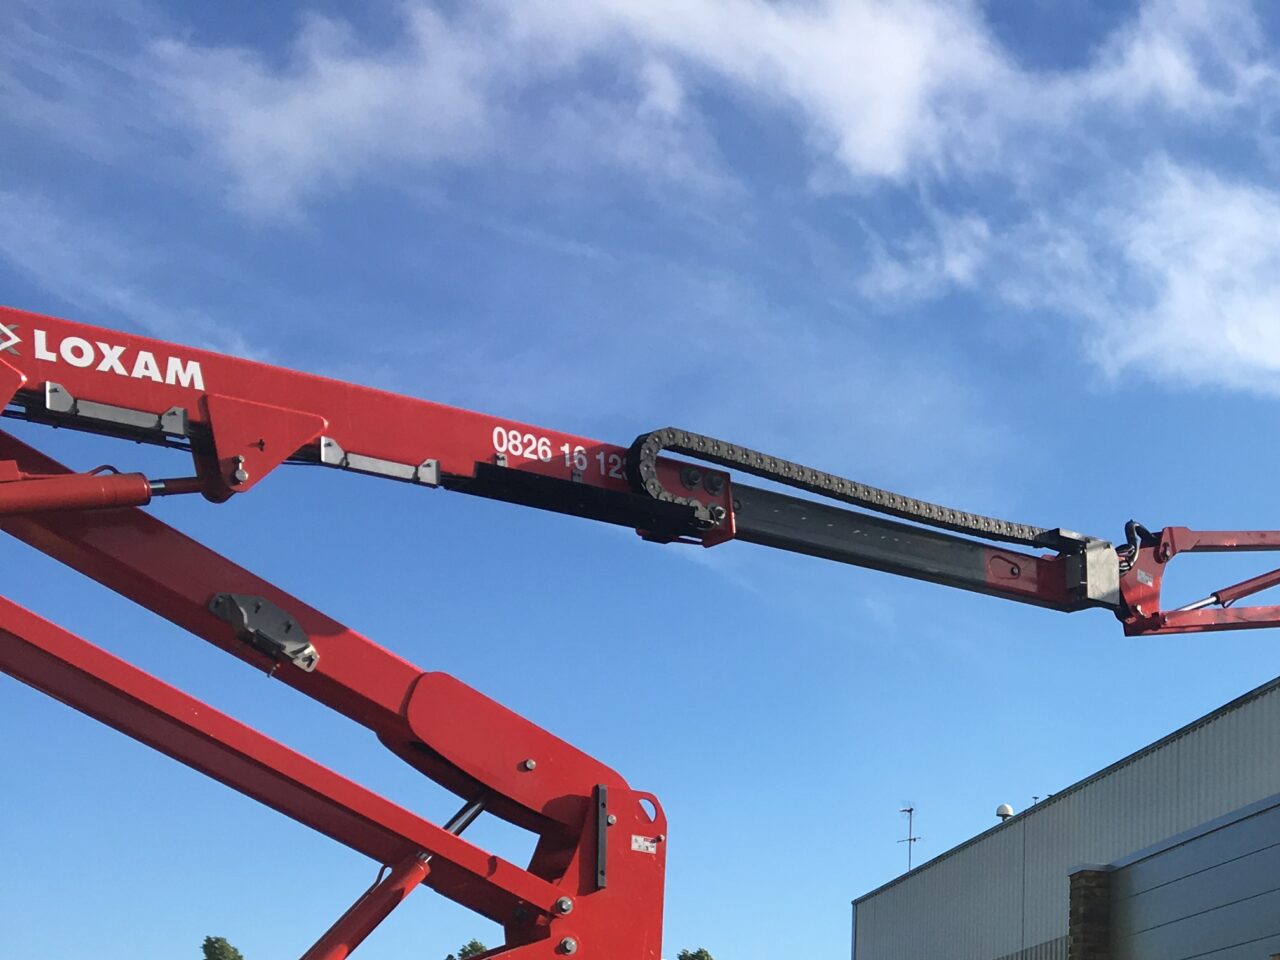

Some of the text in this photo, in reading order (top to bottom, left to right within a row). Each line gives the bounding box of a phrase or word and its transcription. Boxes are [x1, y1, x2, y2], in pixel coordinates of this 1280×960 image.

[33, 328, 205, 391] LOXAM
[492, 426, 552, 463] 0826
[560, 442, 588, 472] 16
